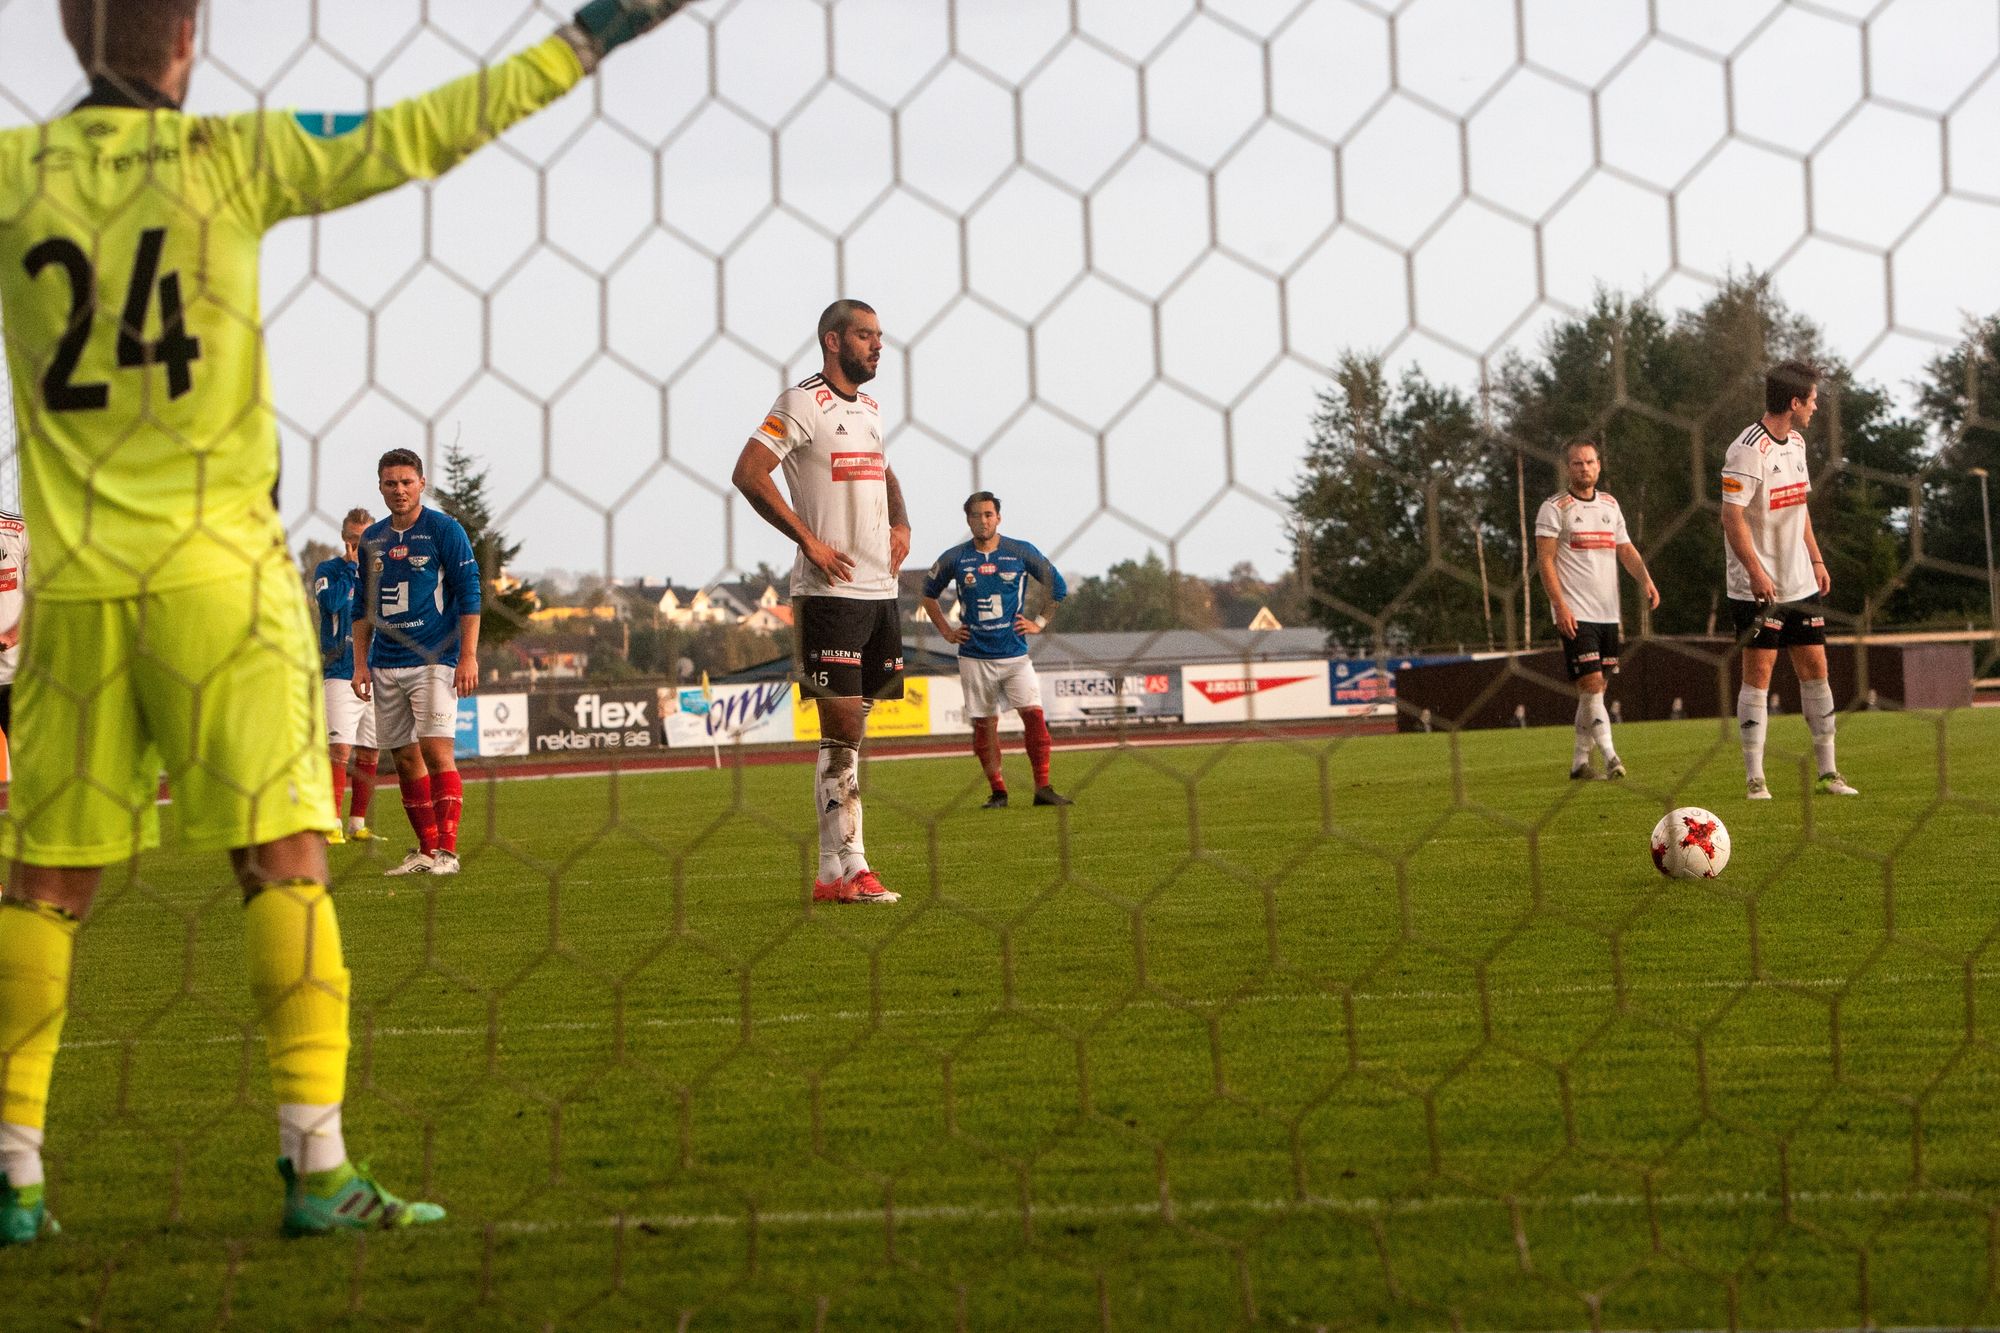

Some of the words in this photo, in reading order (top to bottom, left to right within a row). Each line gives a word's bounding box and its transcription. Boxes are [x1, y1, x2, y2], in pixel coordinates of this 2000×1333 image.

[22, 226, 201, 413] 24
[822, 649, 851, 658] NILSEN
[812, 671, 829, 687] 15
[1055, 678, 1116, 697] BERGEN
[1147, 675, 1168, 693] AS
[574, 694, 650, 729] flex
[536, 729, 621, 752] reklame
[623, 730, 651, 747] as
